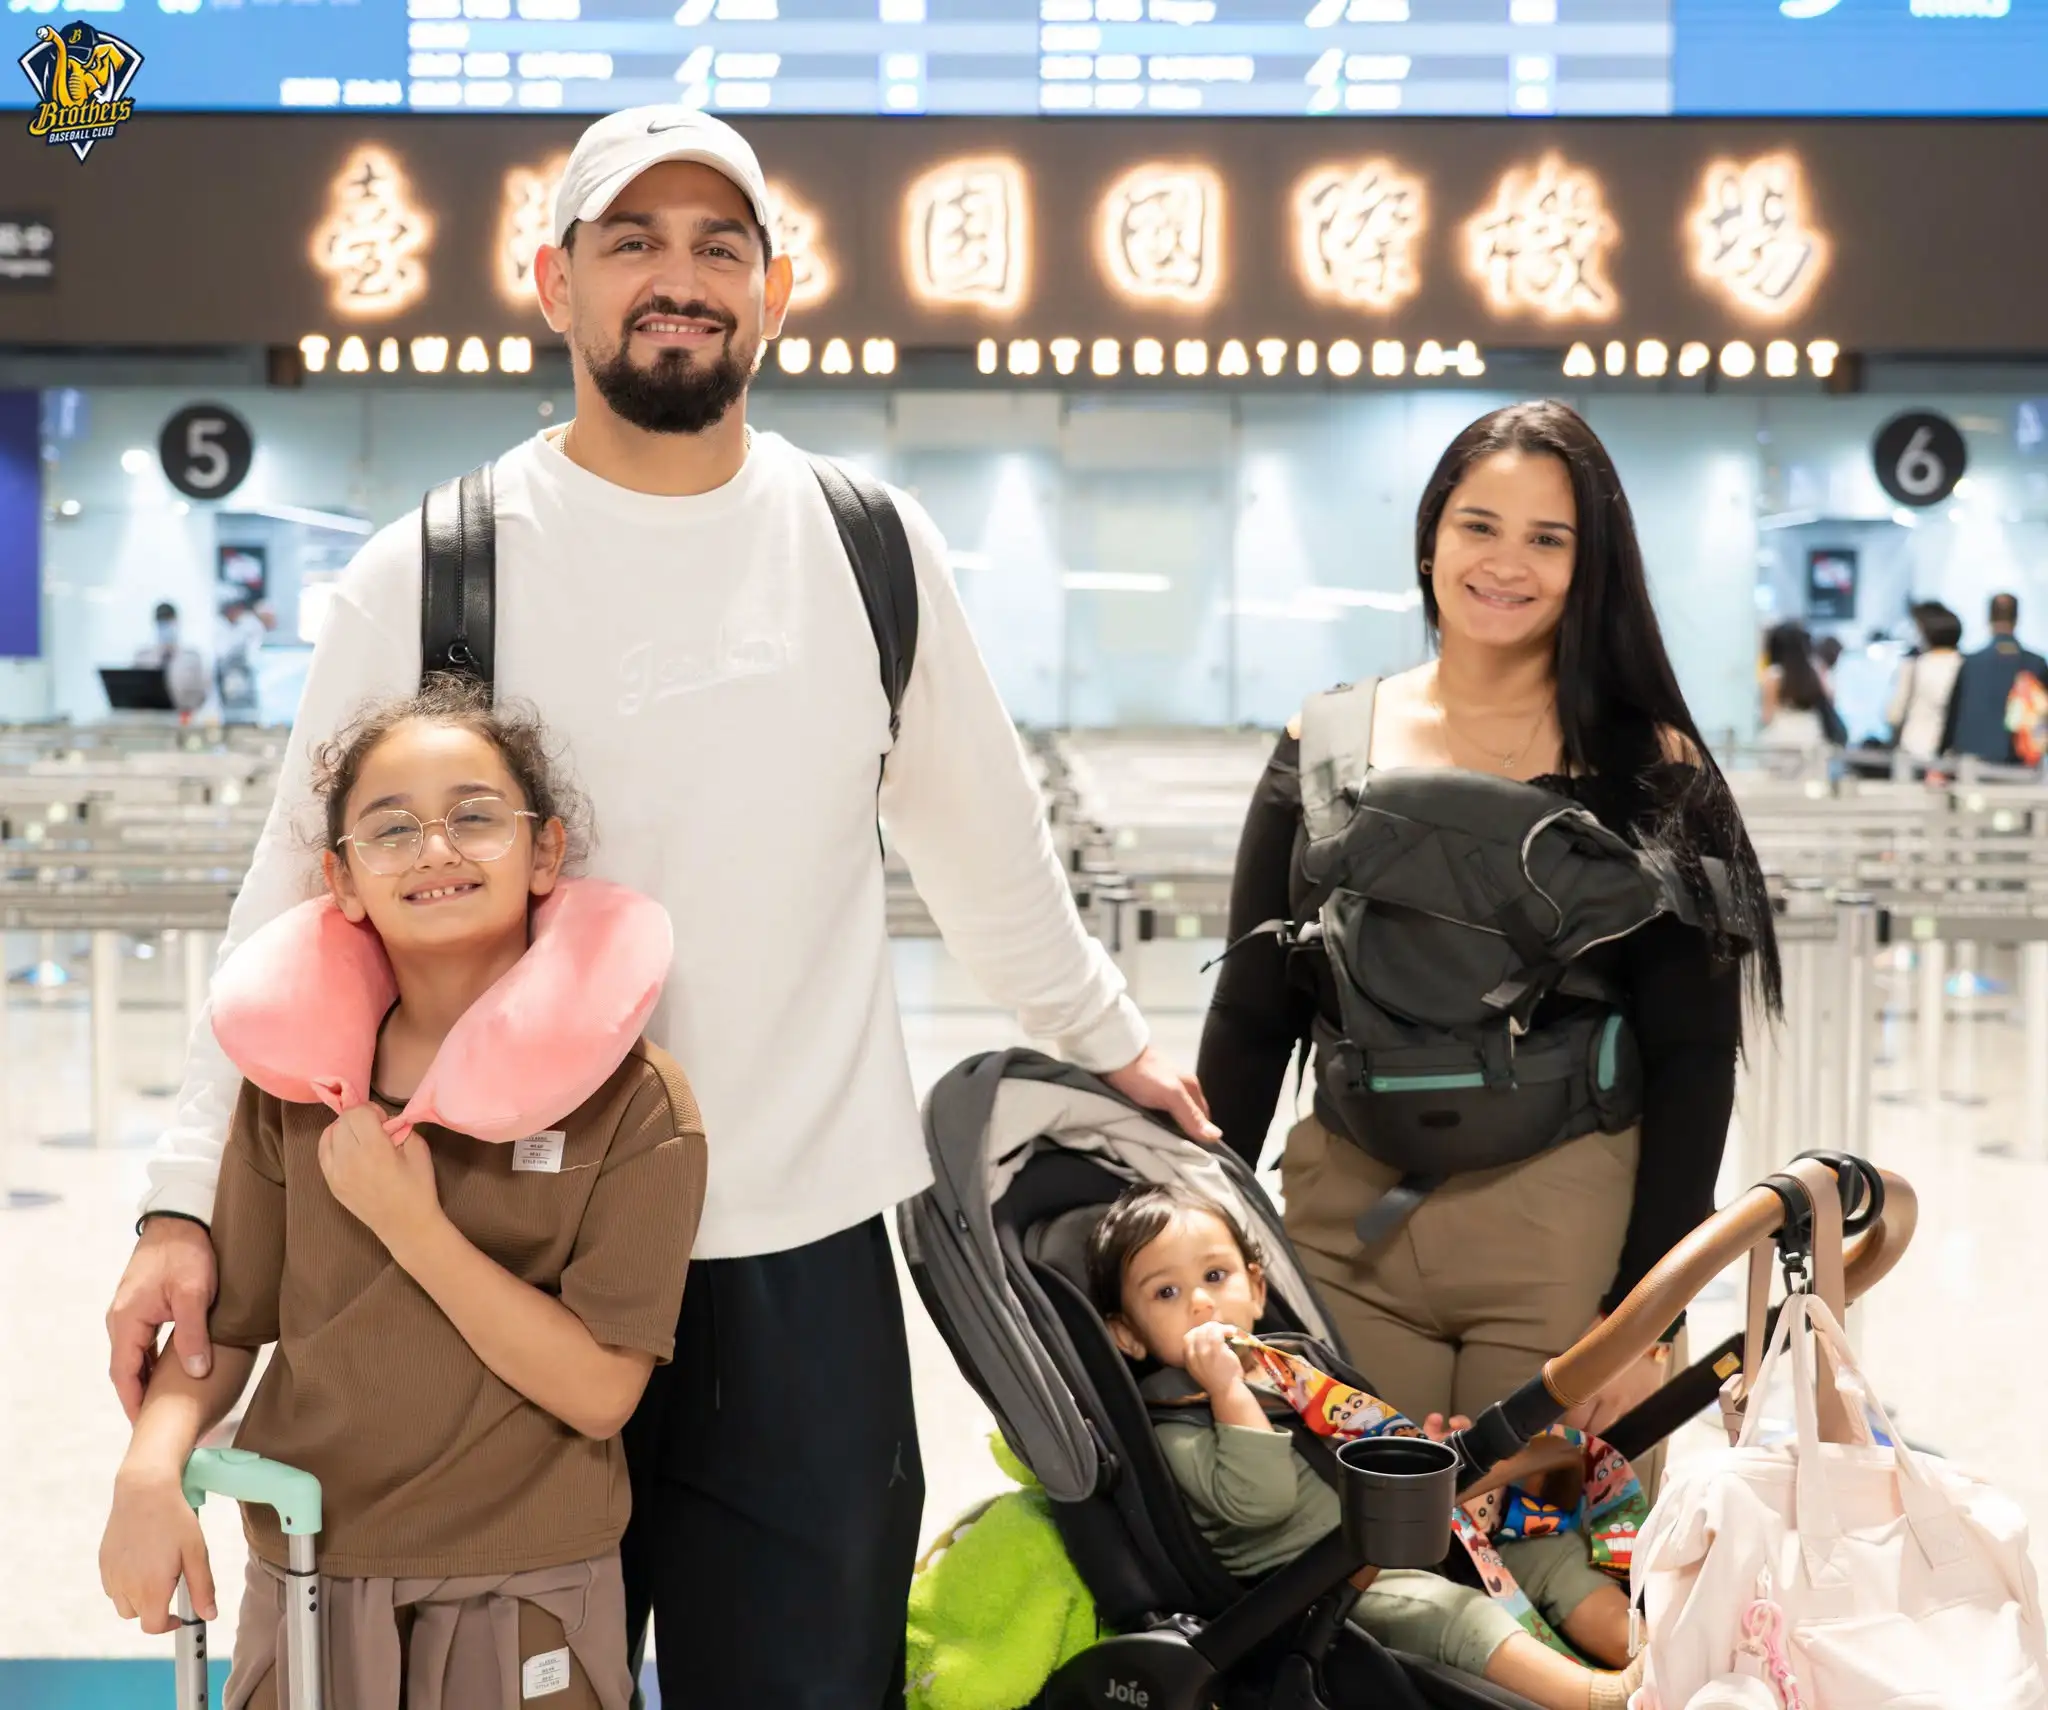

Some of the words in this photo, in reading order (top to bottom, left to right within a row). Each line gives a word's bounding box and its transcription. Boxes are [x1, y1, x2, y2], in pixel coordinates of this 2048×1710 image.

[299, 335, 534, 373] TAIWAN
[757, 337, 896, 375] UAN
[977, 337, 1486, 377] INTERNATIONAL
[1562, 339, 1840, 377] AIRPORT
[184, 418, 231, 490] 5
[1896, 425, 1946, 496] 6
[1104, 1678, 1149, 1708] Joie
